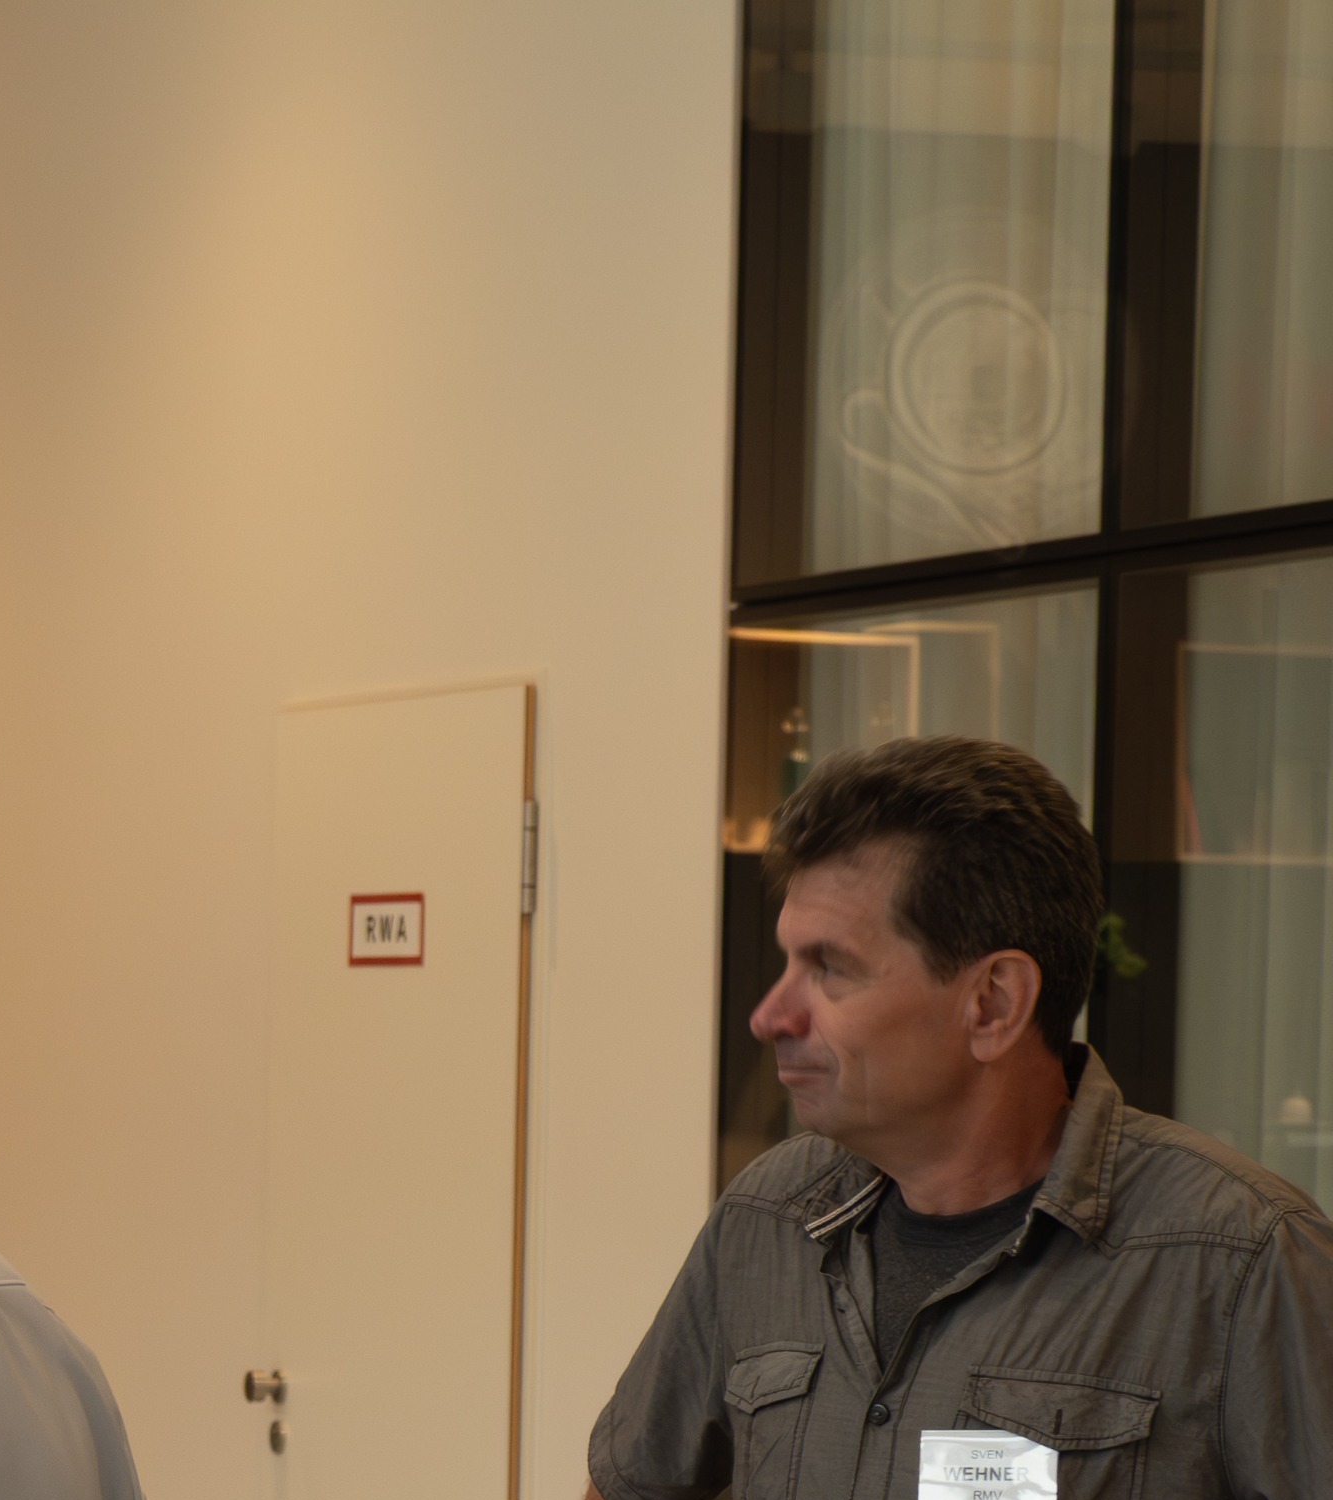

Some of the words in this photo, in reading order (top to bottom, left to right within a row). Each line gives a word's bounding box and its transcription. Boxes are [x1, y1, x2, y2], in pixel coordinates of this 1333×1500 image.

[365, 914, 408, 943] RWA
[970, 1449, 1004, 1460] SVEN
[943, 1466, 1030, 1482] WEHNER
[973, 1490, 1003, 1500] RMV
